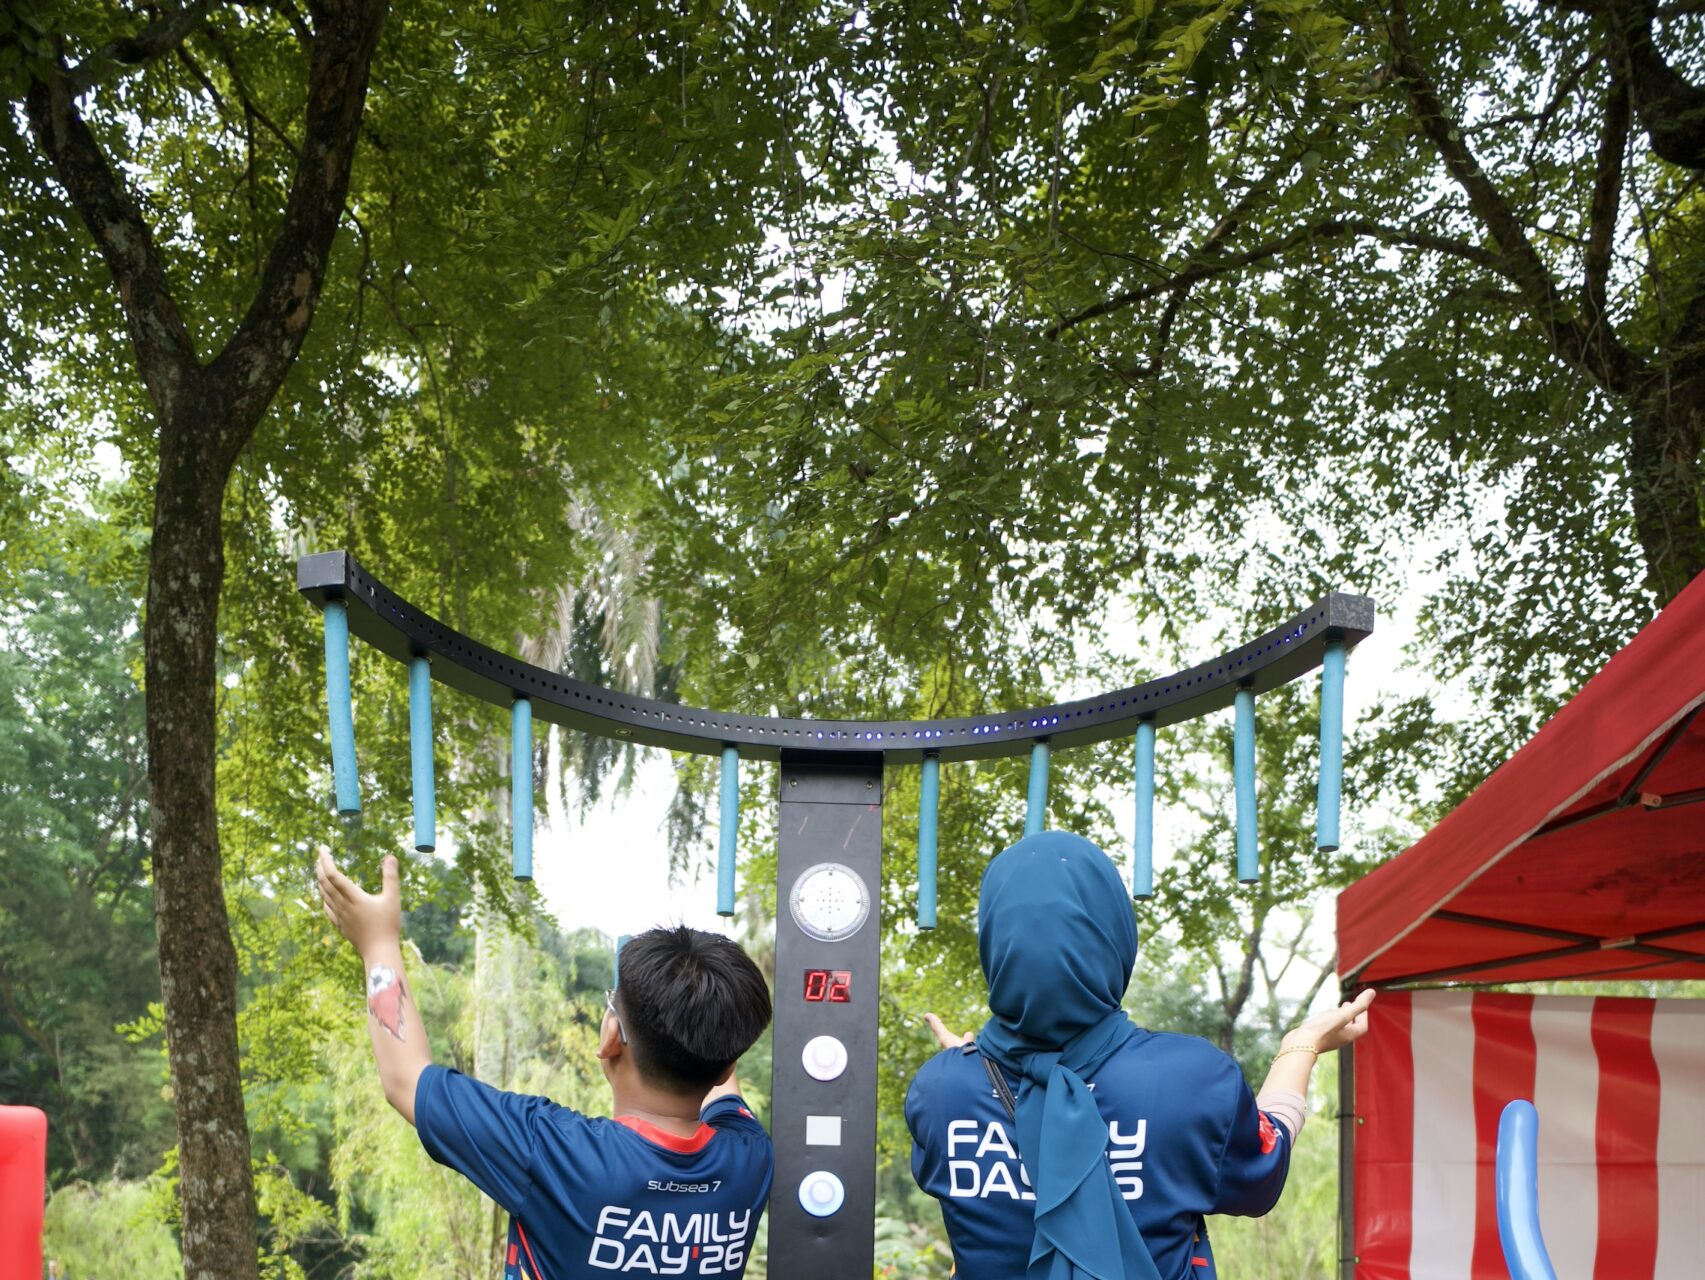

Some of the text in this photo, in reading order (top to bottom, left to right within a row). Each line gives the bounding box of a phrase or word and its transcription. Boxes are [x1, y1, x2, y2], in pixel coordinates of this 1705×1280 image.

[806, 972, 851, 1000] 02
[947, 1119, 1147, 1160] FAY
[647, 1180, 722, 1193] subsea 7
[596, 1205, 751, 1244] FAMILY
